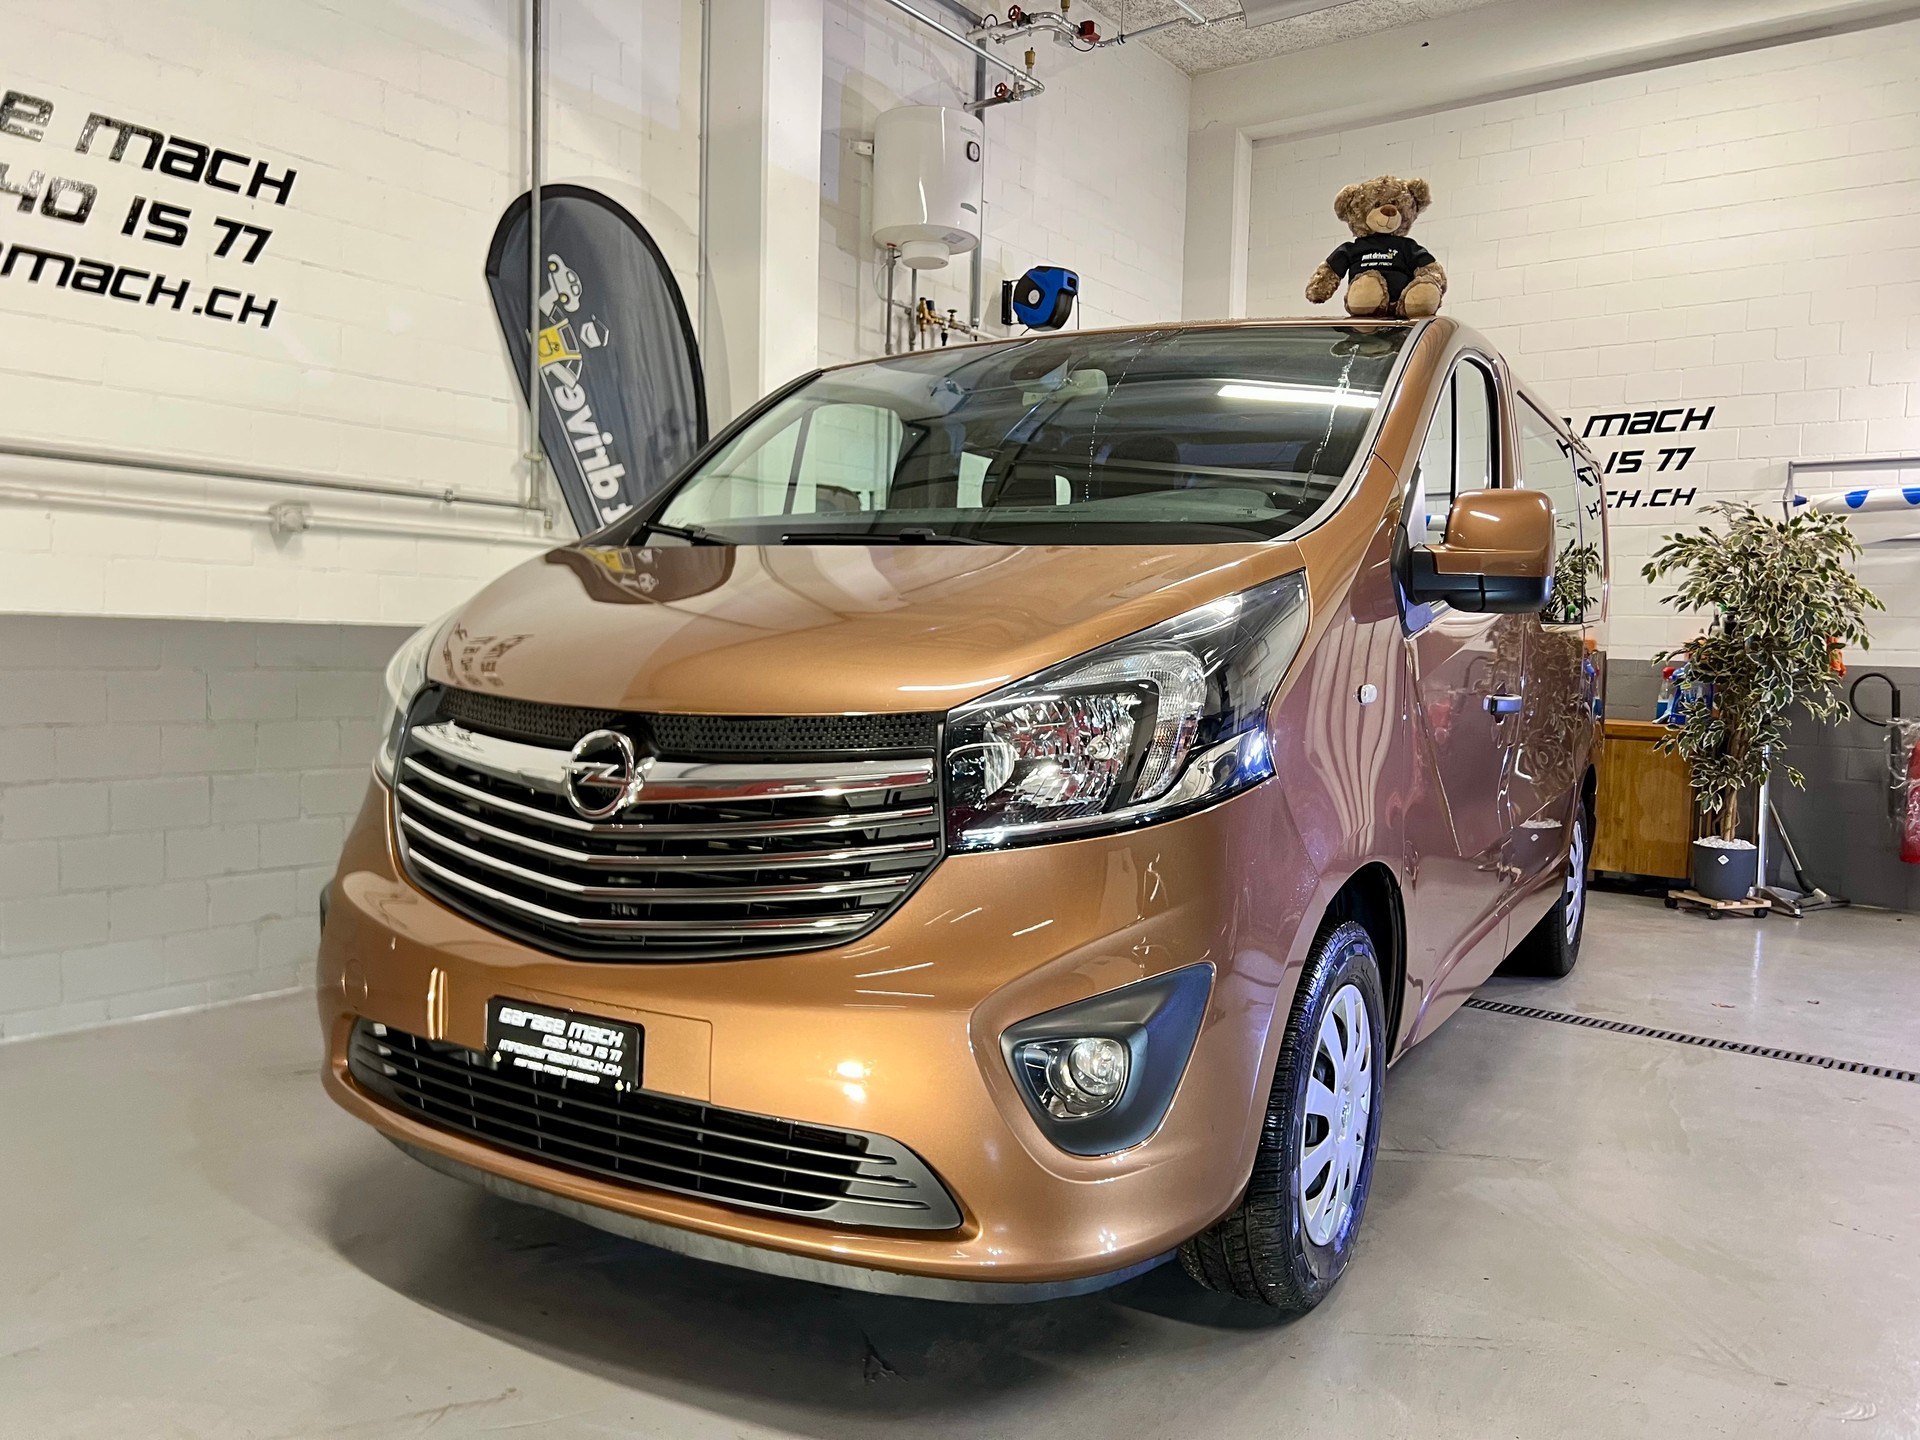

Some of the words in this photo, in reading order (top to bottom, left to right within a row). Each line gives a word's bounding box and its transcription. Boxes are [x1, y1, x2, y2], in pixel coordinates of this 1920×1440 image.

[213, 216, 273, 264] 77
[0, 241, 278, 328] maCH.CH
[1657, 447, 1696, 471] 77
